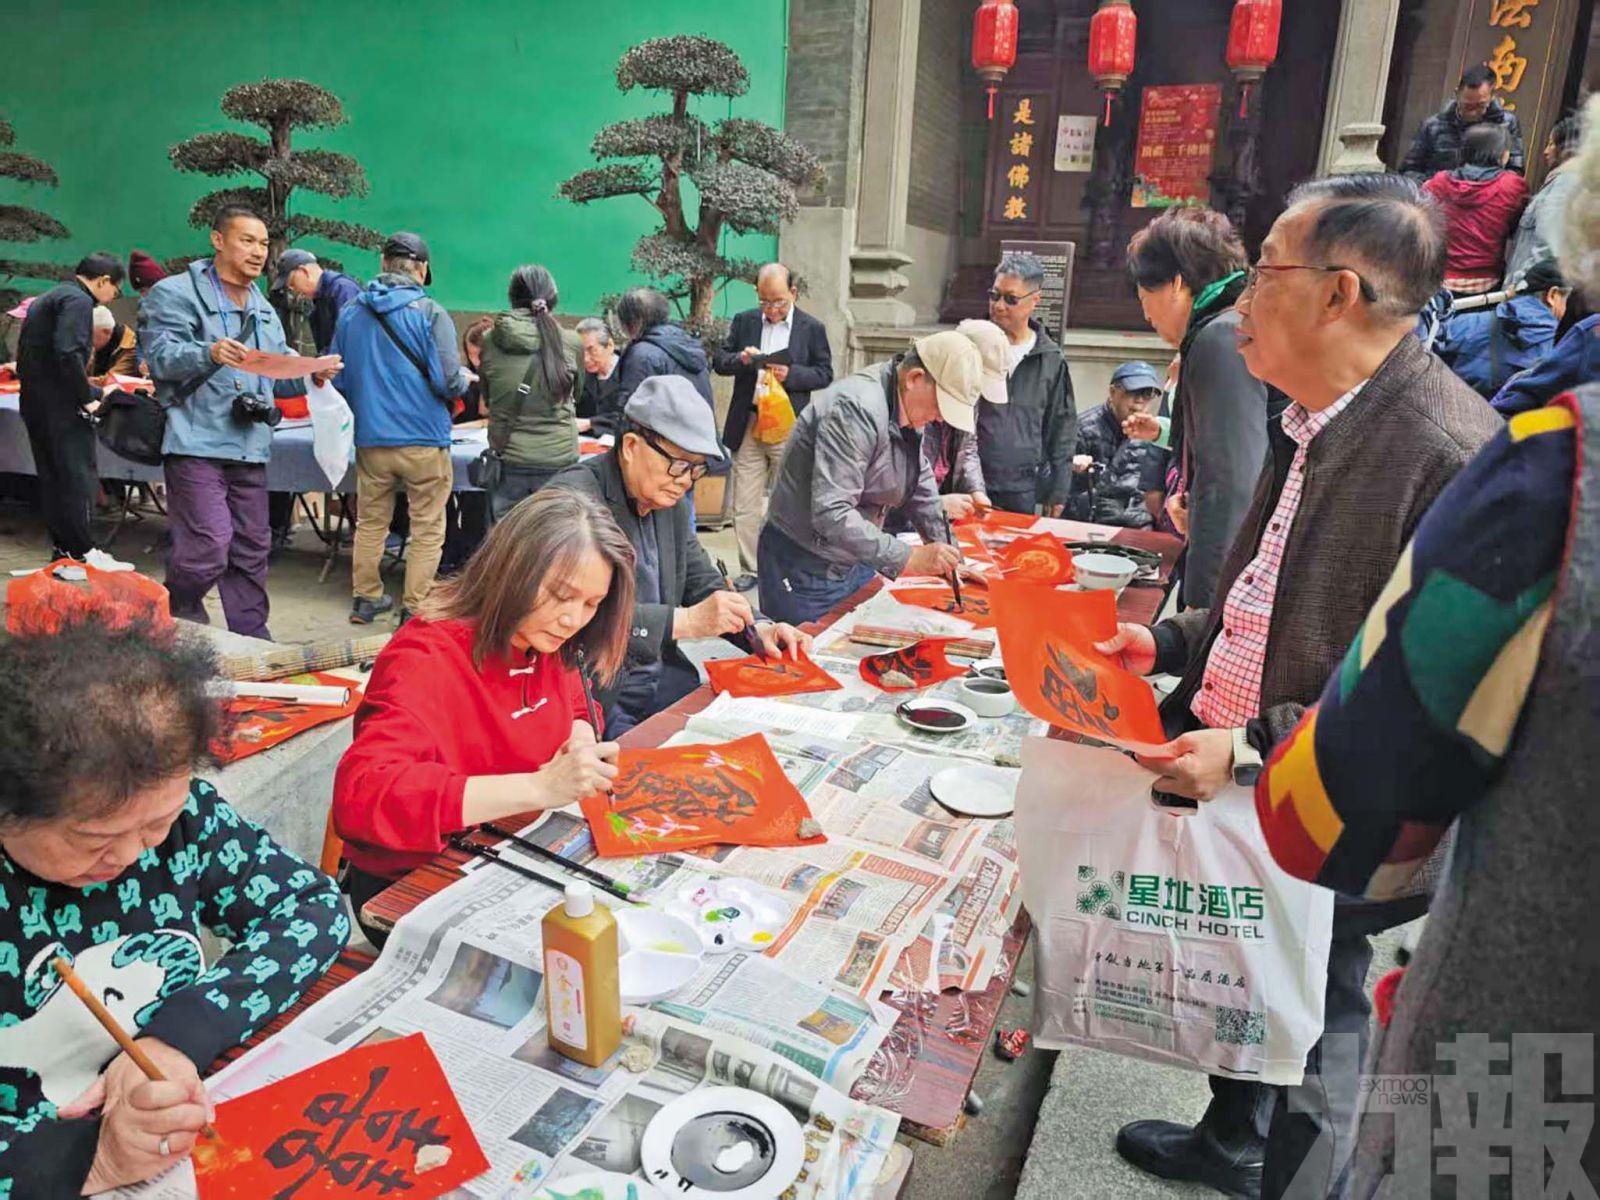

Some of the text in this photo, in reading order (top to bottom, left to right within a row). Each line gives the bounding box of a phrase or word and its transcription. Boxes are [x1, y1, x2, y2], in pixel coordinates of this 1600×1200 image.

[1003, 98, 1035, 219] 是諸佛教
[1127, 874, 1265, 921] 星址酒店
[1126, 911, 1265, 939] CINCH HOTEL
